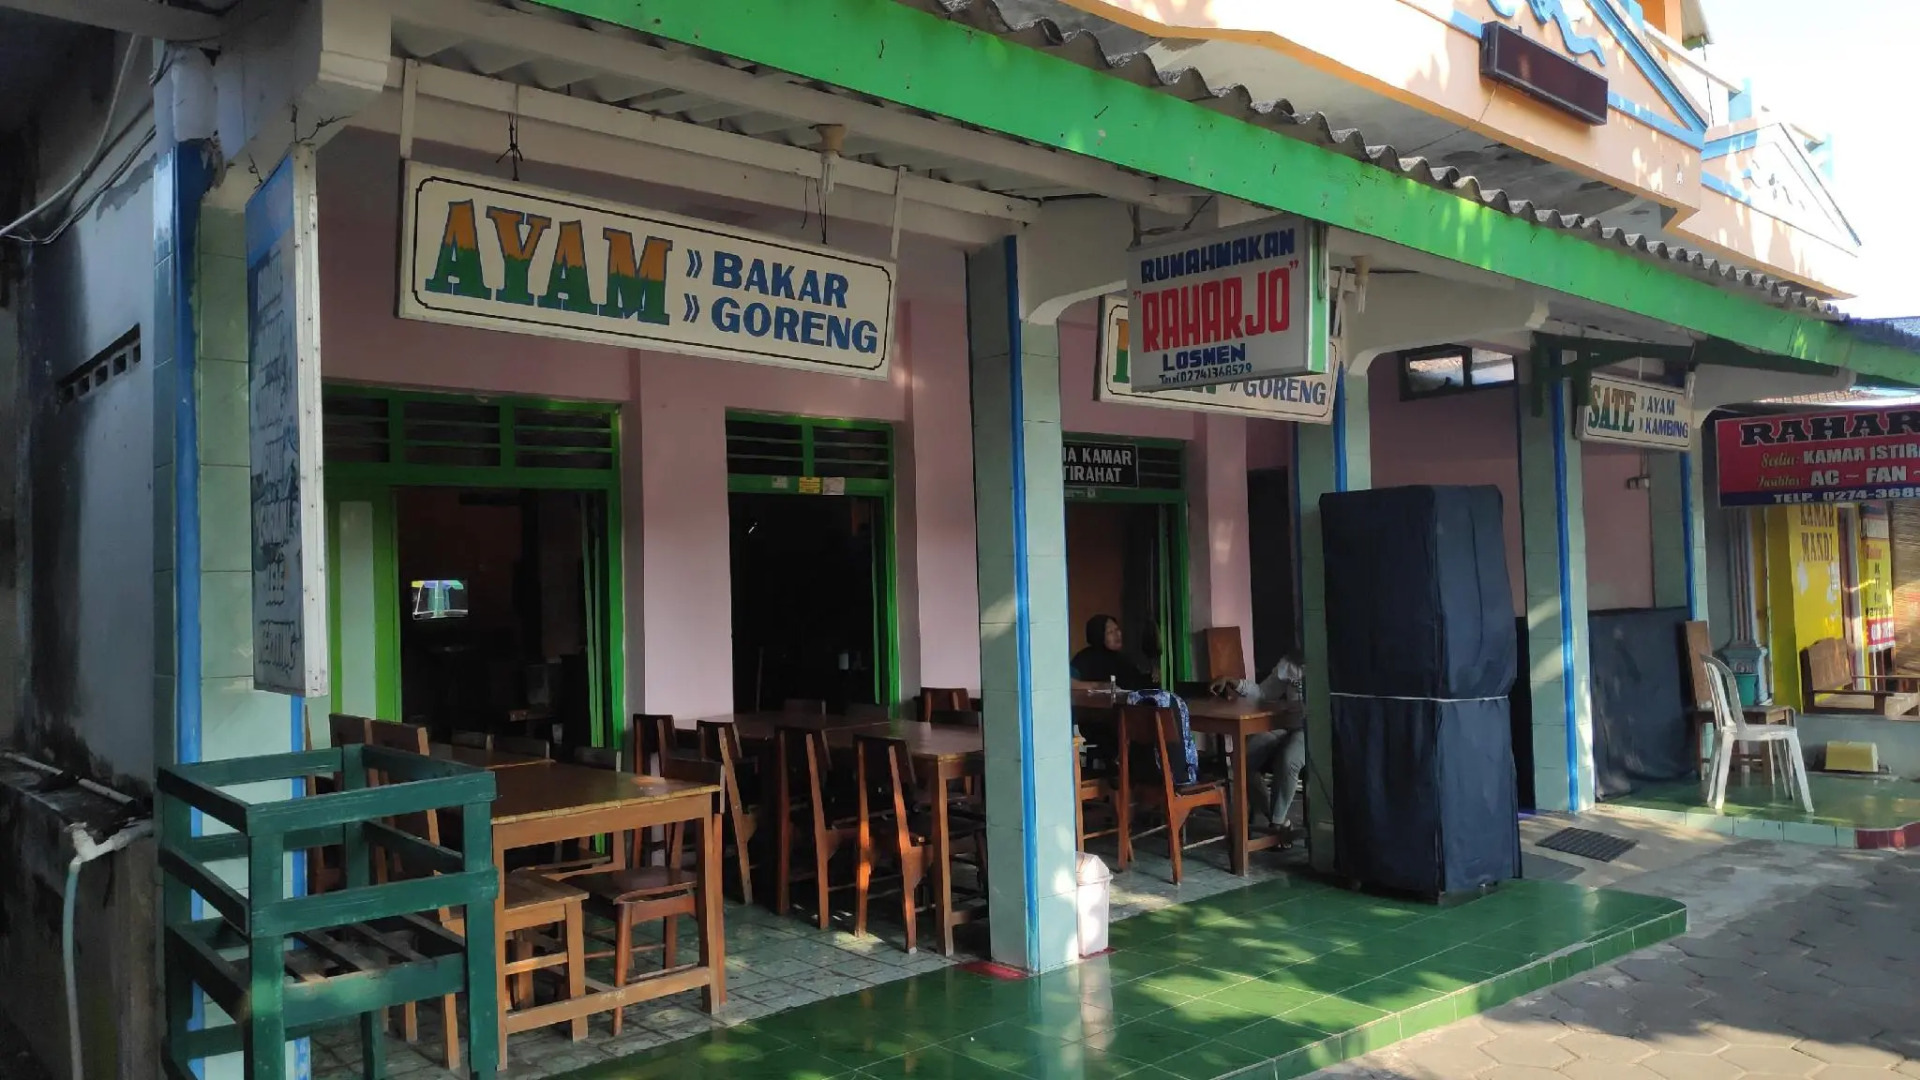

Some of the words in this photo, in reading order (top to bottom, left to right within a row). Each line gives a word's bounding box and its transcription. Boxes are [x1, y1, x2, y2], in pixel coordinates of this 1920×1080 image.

[425, 199, 673, 326] AYAM
[712, 250, 849, 309] BAKAR
[711, 296, 878, 355] GORENG
[1163, 343, 1245, 371] LOSMEN
[1243, 378, 1326, 405] GORENG
[1588, 384, 1636, 433] SATE
[1647, 396, 1675, 415] AYAM
[1645, 417, 1689, 438] KAMBING
[1740, 410, 1920, 447] RAHAR
[1082, 447, 1133, 465] KAMAR
[1803, 447, 1865, 464] KAMAR
[1869, 443, 1920, 460] ISTIR
[1810, 470, 1839, 486] AC
[1866, 465, 1907, 483] FAN
